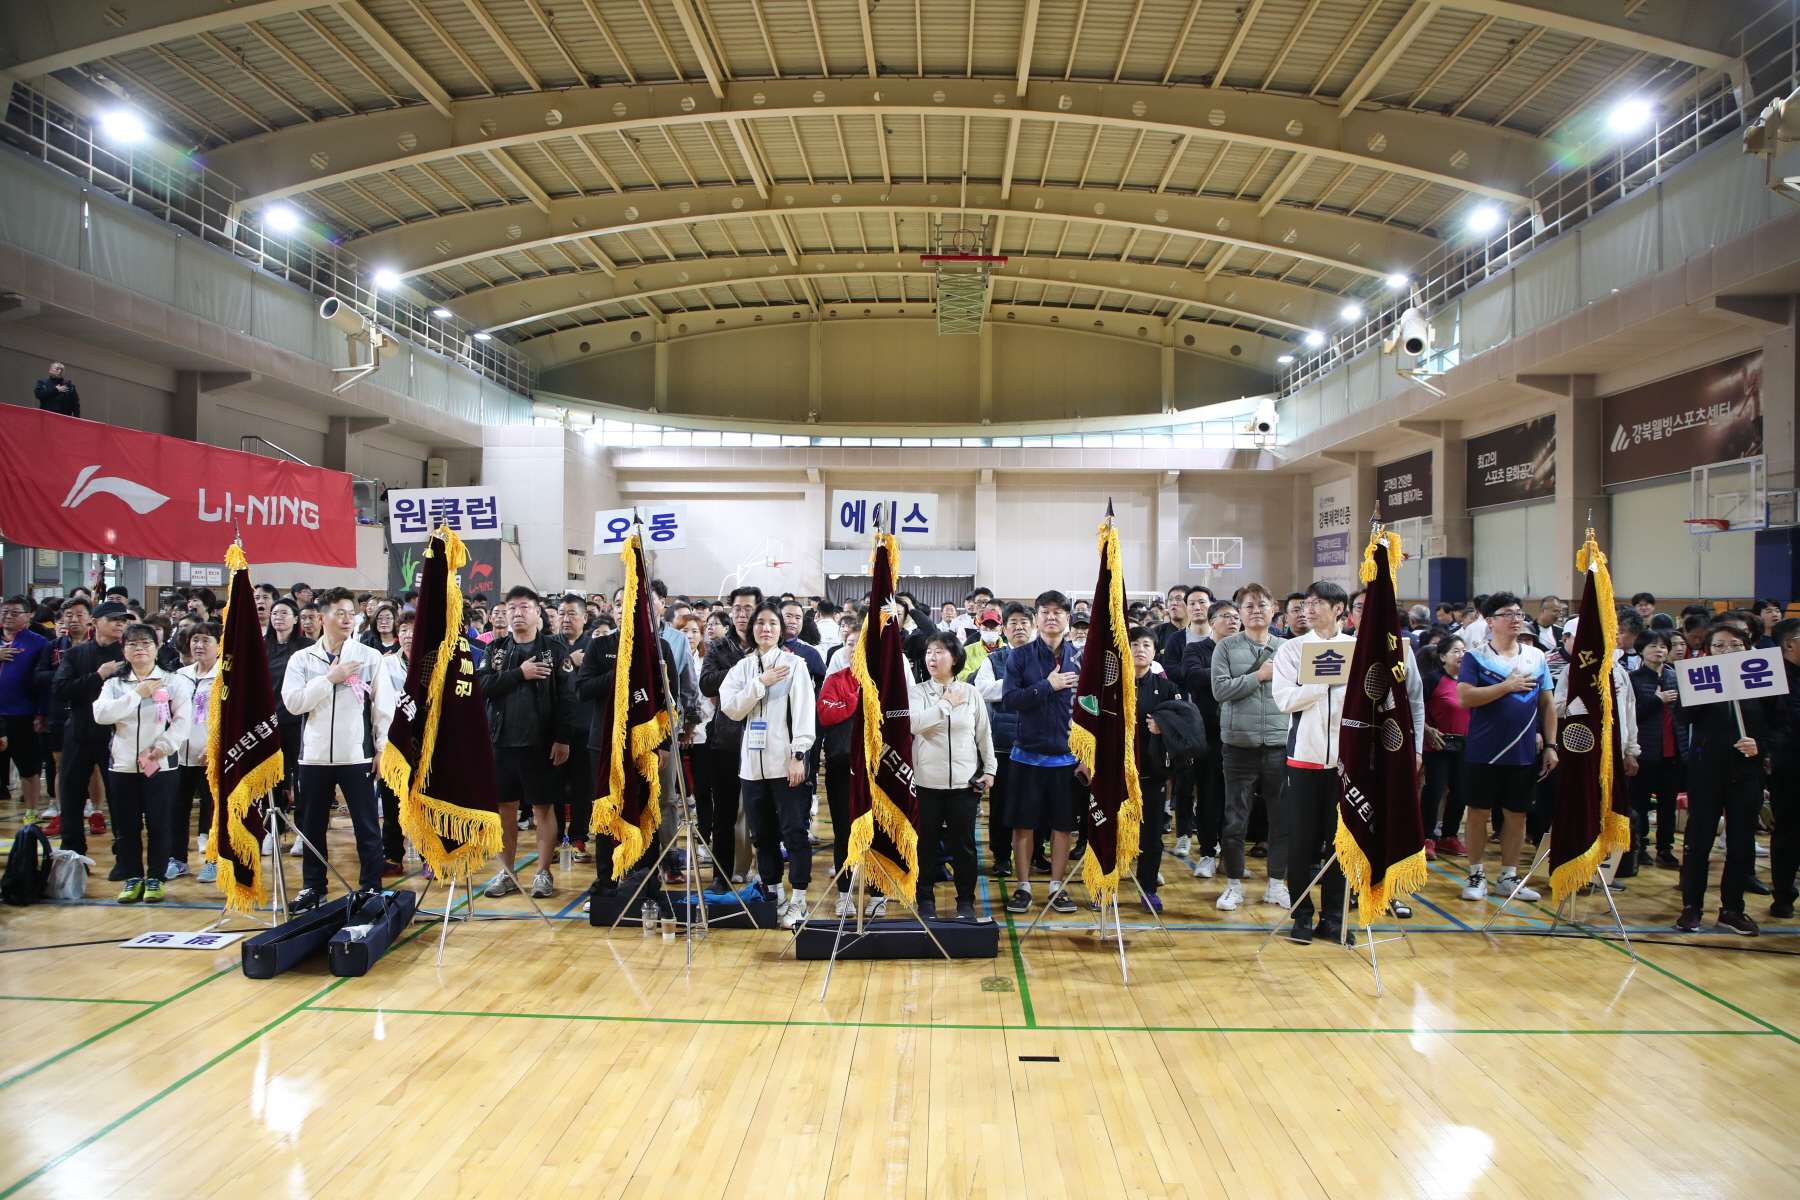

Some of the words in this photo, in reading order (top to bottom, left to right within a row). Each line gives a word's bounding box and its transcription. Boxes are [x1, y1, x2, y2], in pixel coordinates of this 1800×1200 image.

[1632, 401, 1731, 444] 강북웰빙스포츠센터
[1477, 451, 1497, 469] 최고의
[1485, 468, 1505, 486] 스포츠
[1506, 462, 1534, 482] 문화공간
[198, 488, 320, 530] LI-NING
[393, 496, 498, 533] 원클럽
[840, 500, 929, 535] 에이스
[1319, 506, 1351, 529] 강북체력인증
